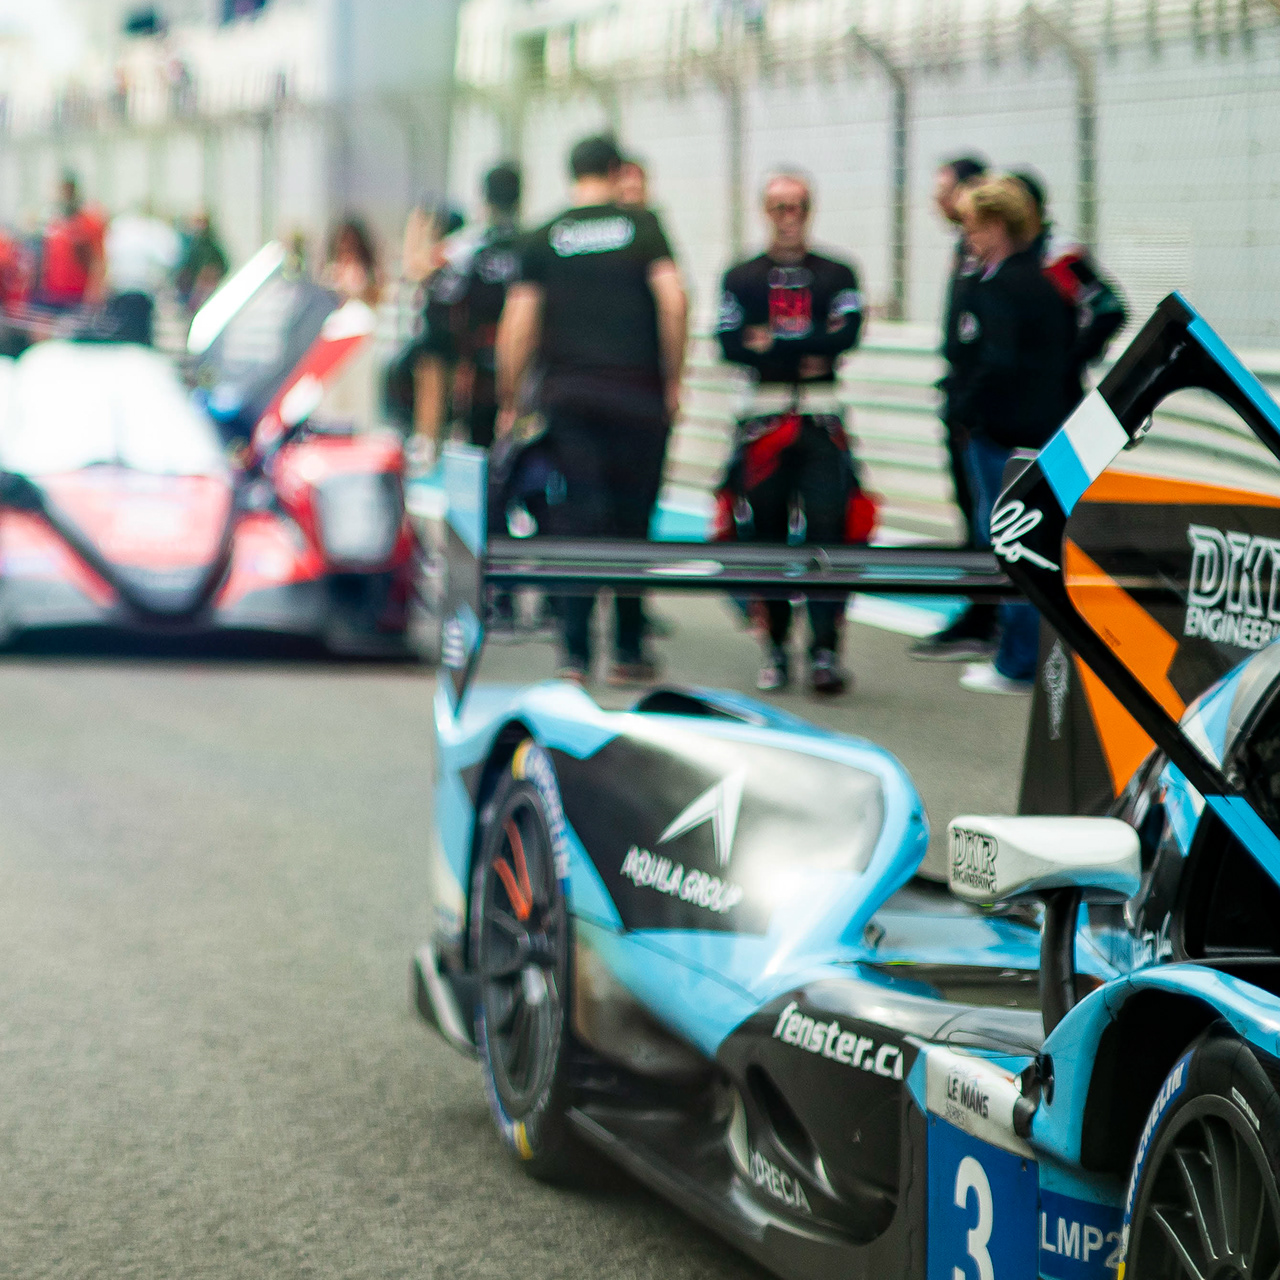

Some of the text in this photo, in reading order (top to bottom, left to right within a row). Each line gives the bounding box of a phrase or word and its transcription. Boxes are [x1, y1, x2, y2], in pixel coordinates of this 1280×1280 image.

[1187, 523, 1280, 622] DK
[620, 844, 743, 914] AQUILA GROUP
[947, 1073, 959, 1101] LE
[961, 1081, 989, 1119] MANS
[954, 1155, 996, 1280] 3
[1041, 1211, 1123, 1269] LMP2
